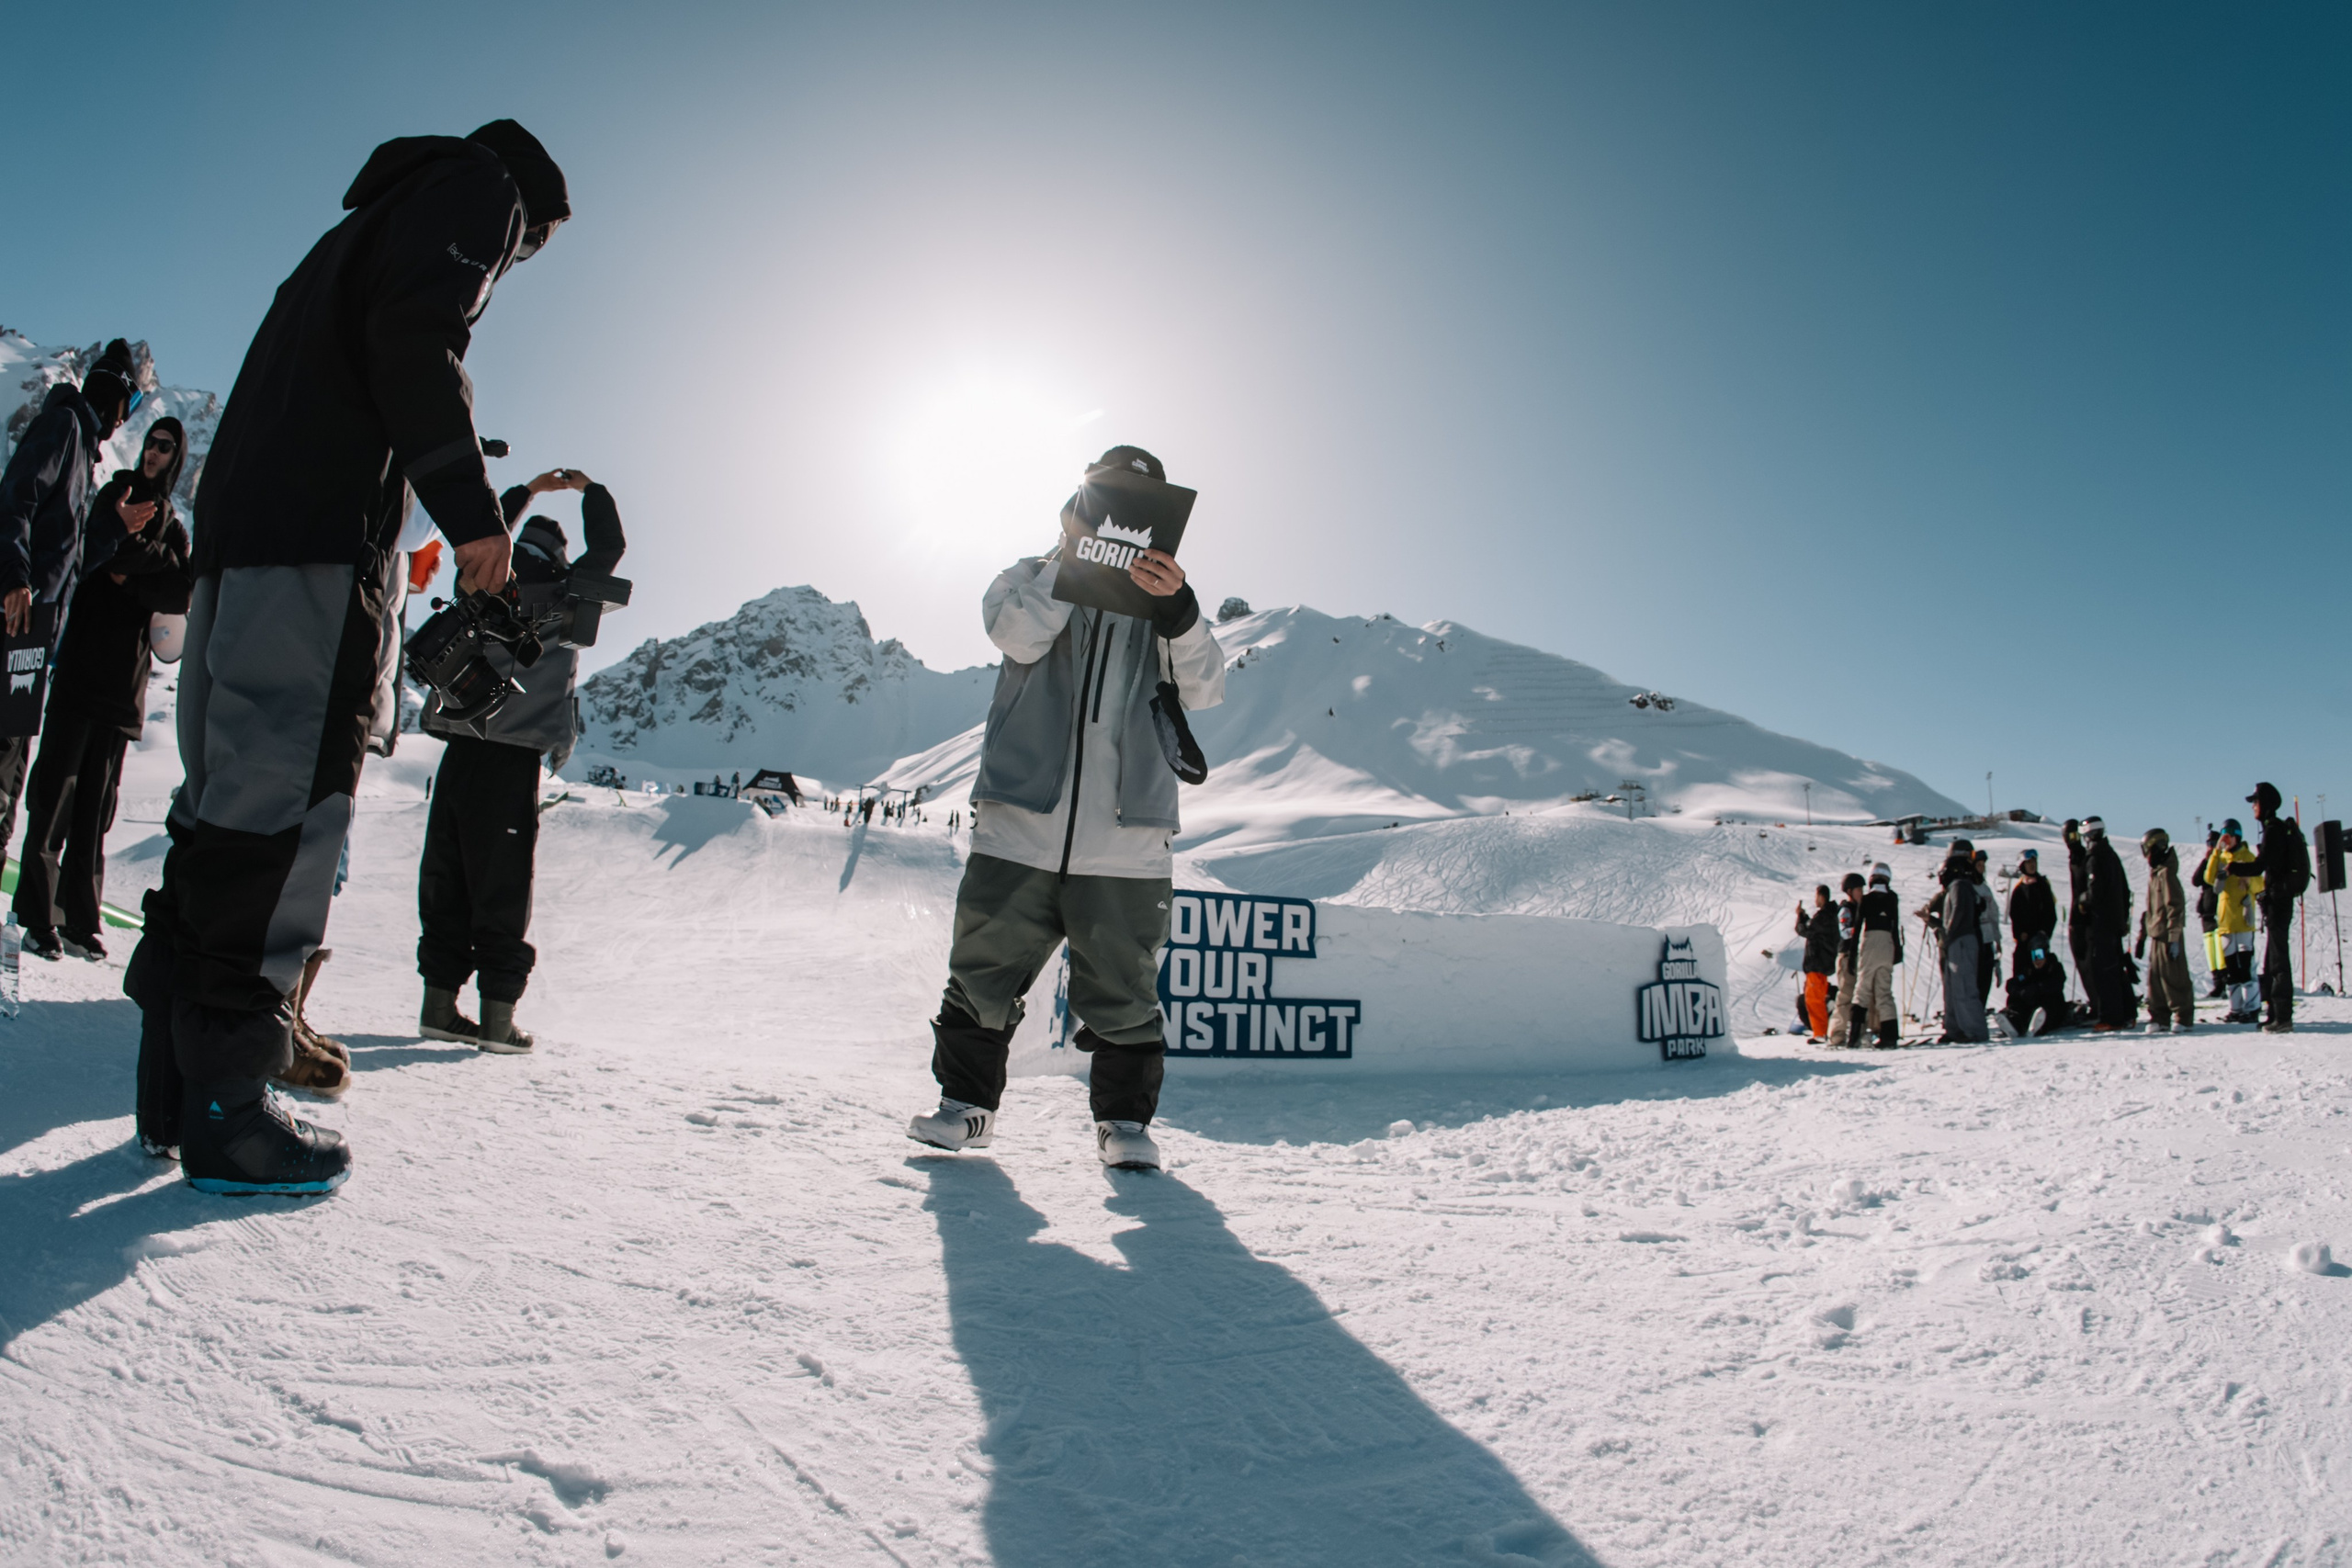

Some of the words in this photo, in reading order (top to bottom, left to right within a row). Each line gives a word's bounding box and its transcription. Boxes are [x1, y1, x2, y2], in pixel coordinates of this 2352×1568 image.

[1076, 536, 1158, 570] GORIL
[7, 647, 45, 671] GORILLA
[1170, 896, 1311, 952] OWER
[1156, 1000, 1356, 1053] NSTINCT
[1668, 1037, 1705, 1057] PARK
